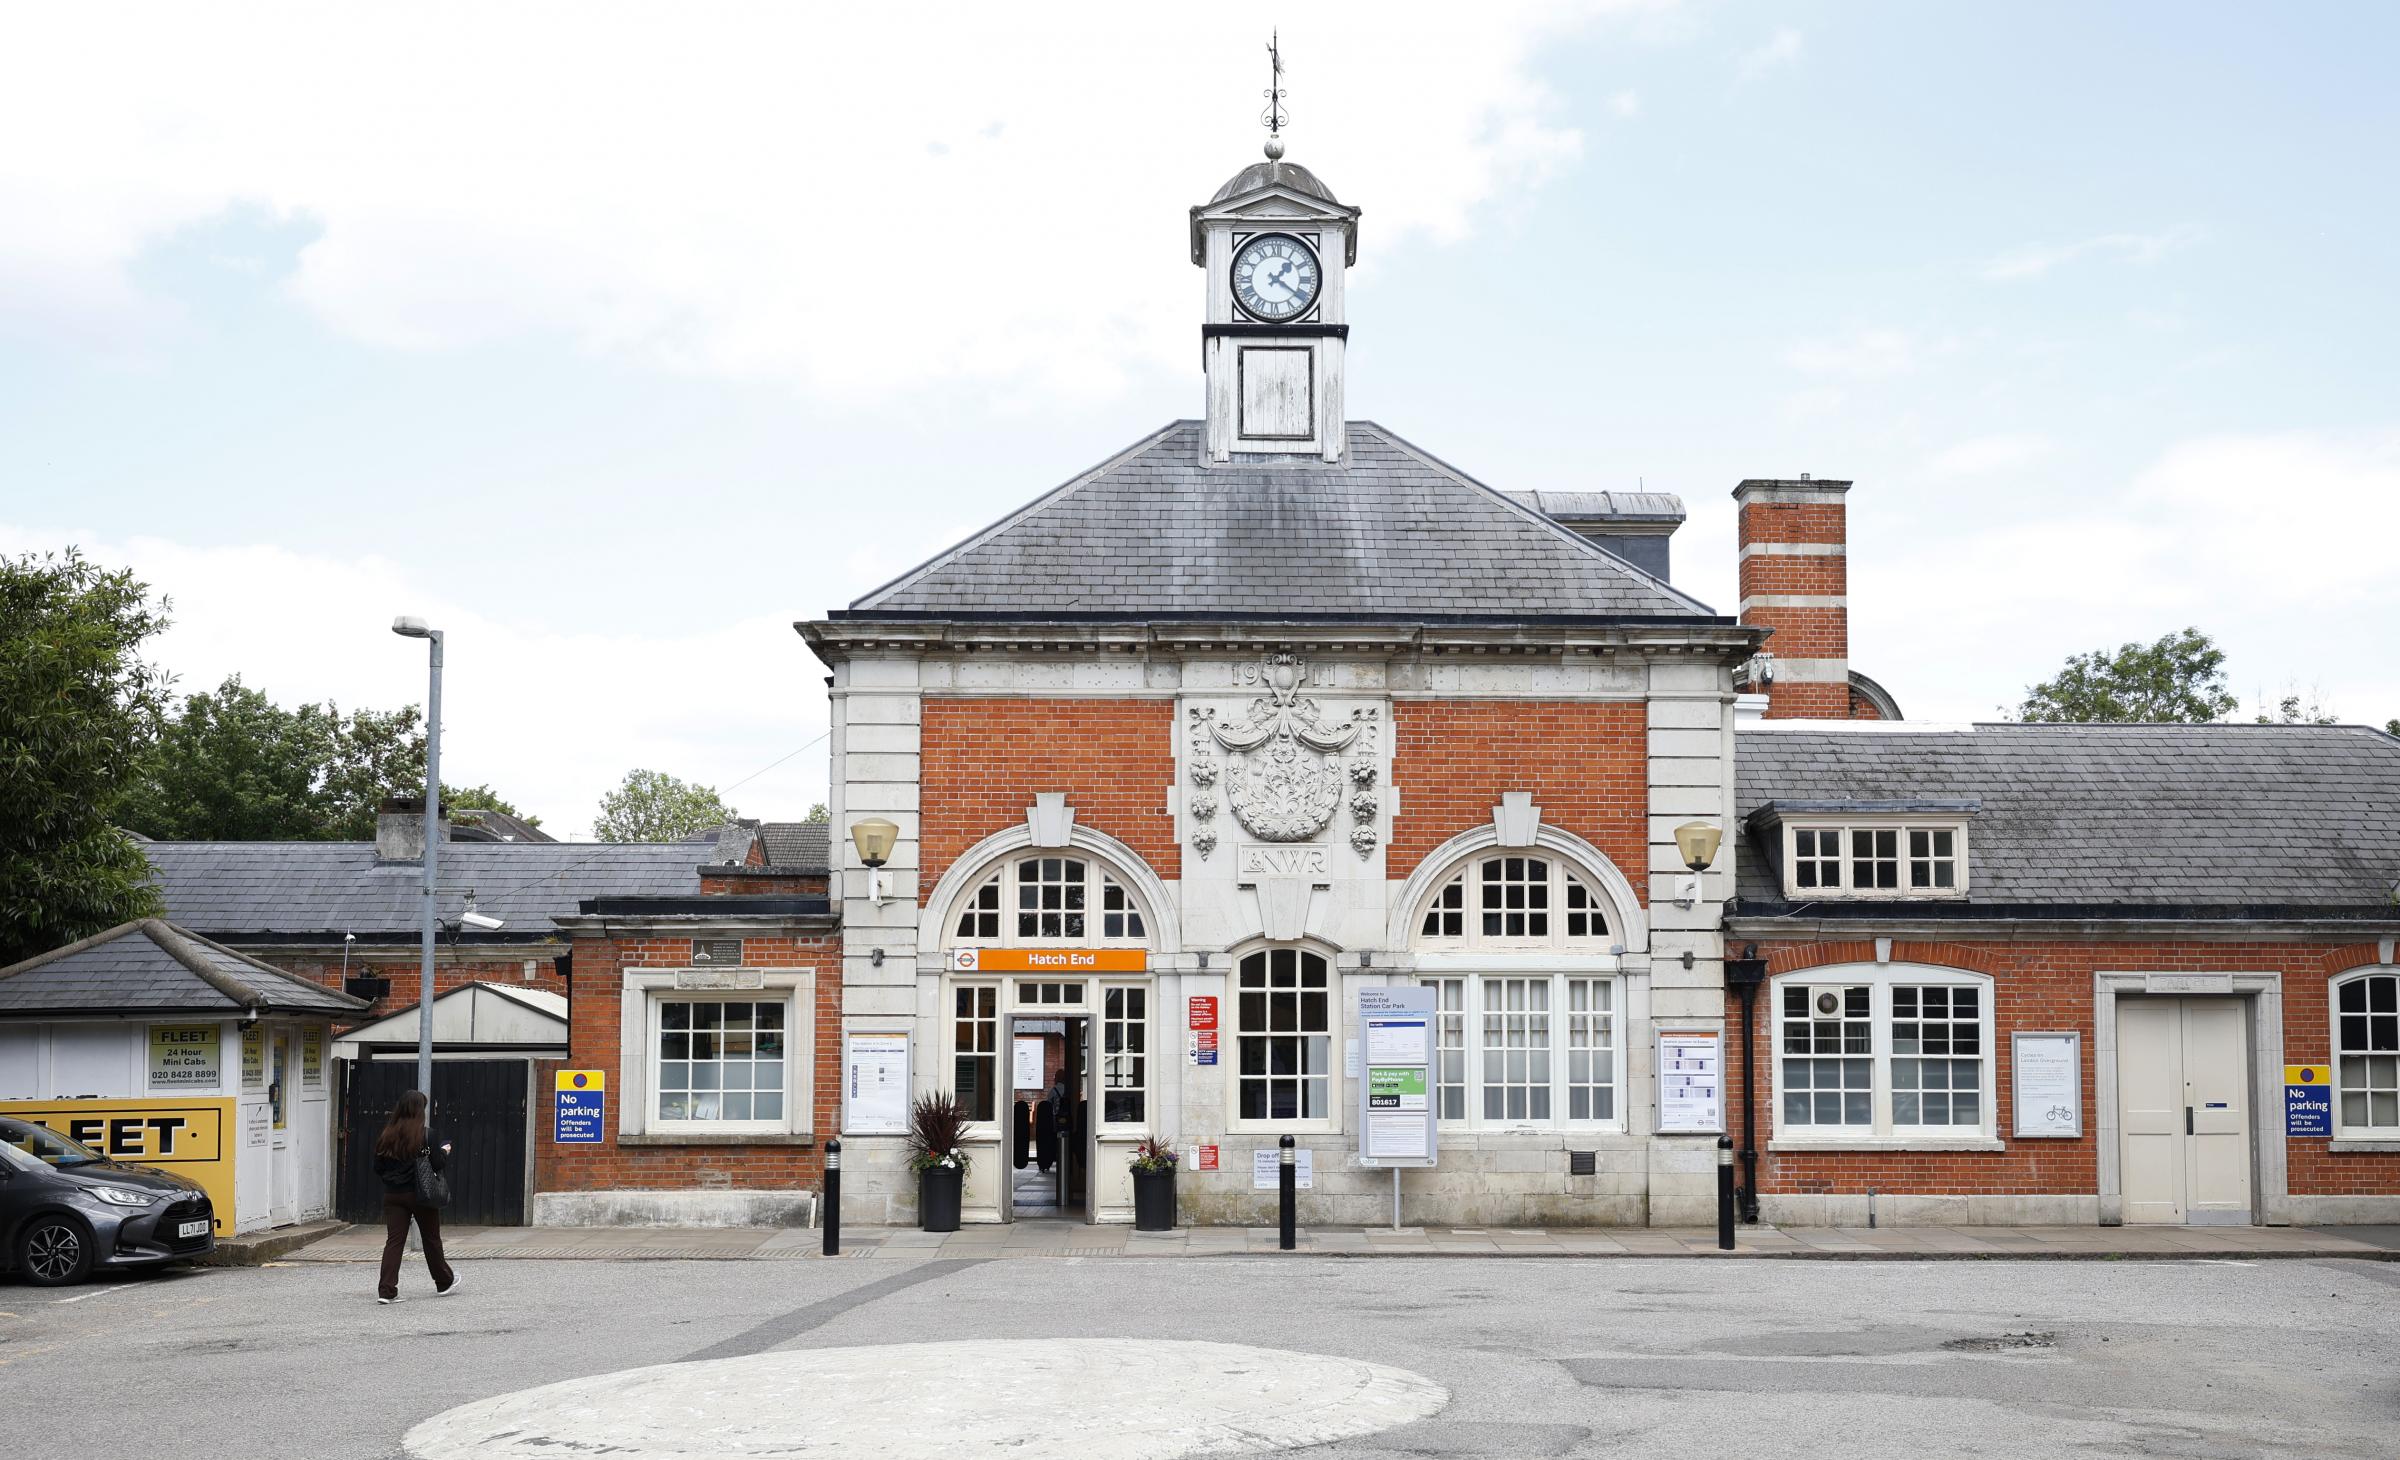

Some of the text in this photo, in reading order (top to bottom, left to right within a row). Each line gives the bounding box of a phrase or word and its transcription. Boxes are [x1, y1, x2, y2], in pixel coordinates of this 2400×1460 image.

[1028, 953, 1095, 965] Hatch End
[161, 1030, 209, 1042] FLEET
[167, 1048, 202, 1056] 24 Hour
[162, 1058, 207, 1066] Mini Cabs
[151, 1070, 217, 1079] 020 8428 8899
[2289, 1089, 2306, 1098] No
[560, 1094, 578, 1104] No
[2289, 1100, 2329, 1113] parking
[560, 1106, 601, 1118] parking
